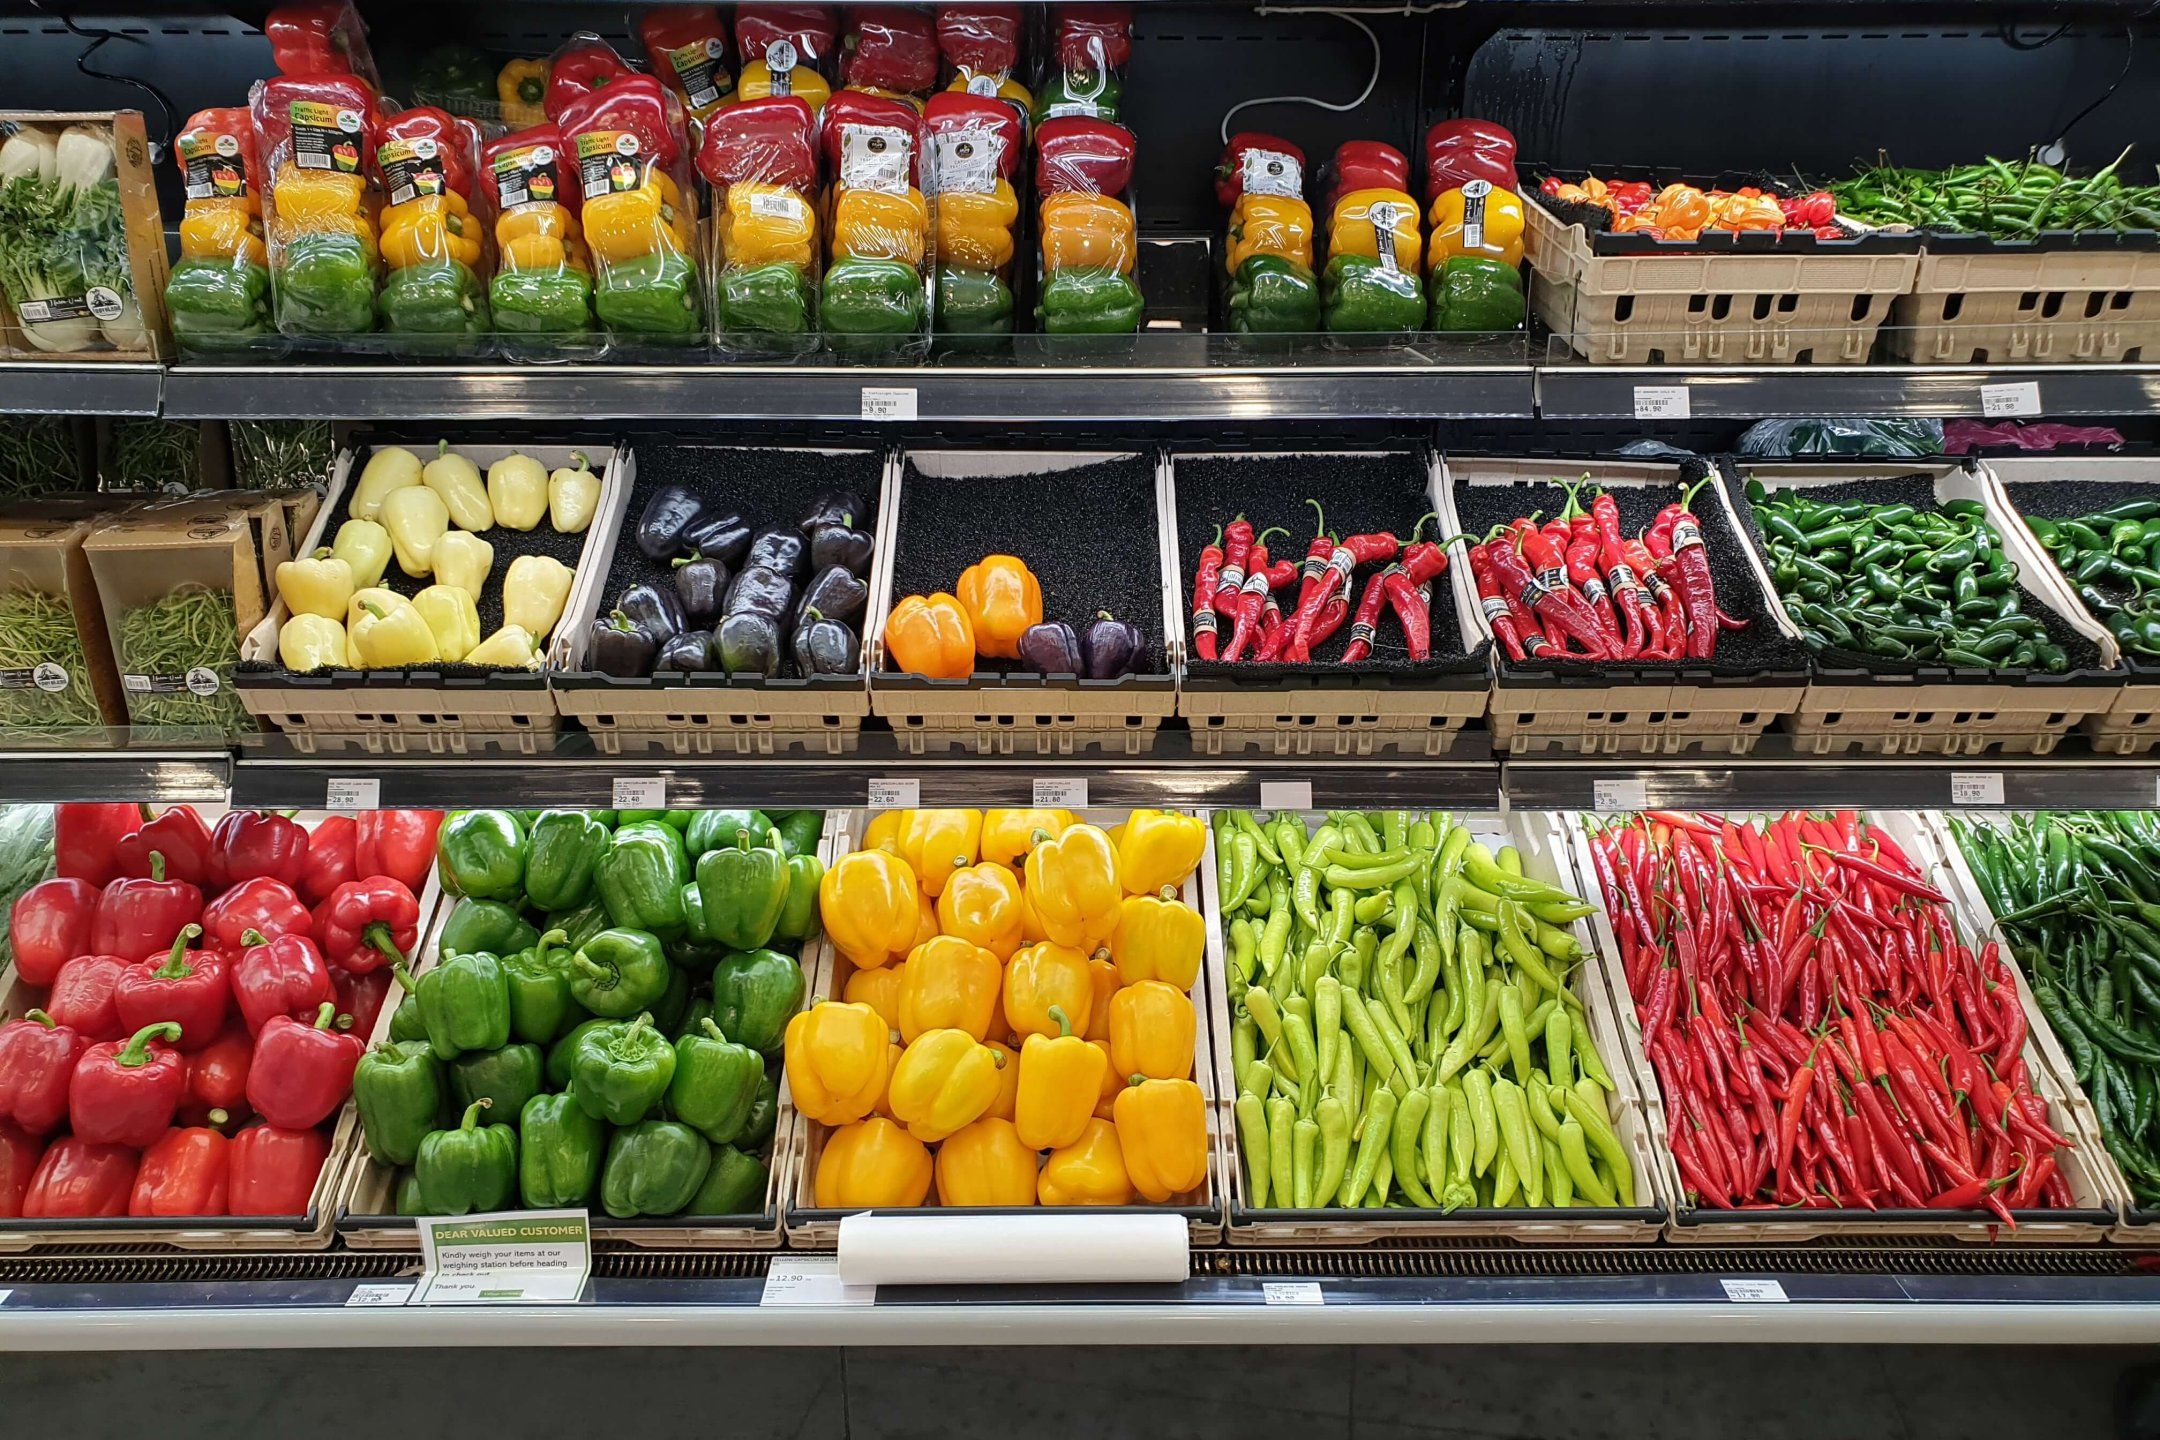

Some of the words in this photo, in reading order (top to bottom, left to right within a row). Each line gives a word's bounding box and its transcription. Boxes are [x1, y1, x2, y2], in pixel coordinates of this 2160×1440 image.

[676, 52, 705, 68] Capsicum
[294, 106, 313, 114] Traffic
[294, 112, 332, 124] Capsicum
[582, 143, 612, 154] Capsicum
[380, 150, 410, 162] Capsicum
[869, 406, 886, 414] 9.90
[435, 1230, 468, 1240] DEAR
[471, 1228, 516, 1238] VALUED
[520, 1226, 583, 1236] CUSTOMER
[442, 1252, 466, 1260] Kindly
[468, 1251, 492, 1260] weigh
[443, 1261, 478, 1270] weighing
[537, 1259, 567, 1267] heading
